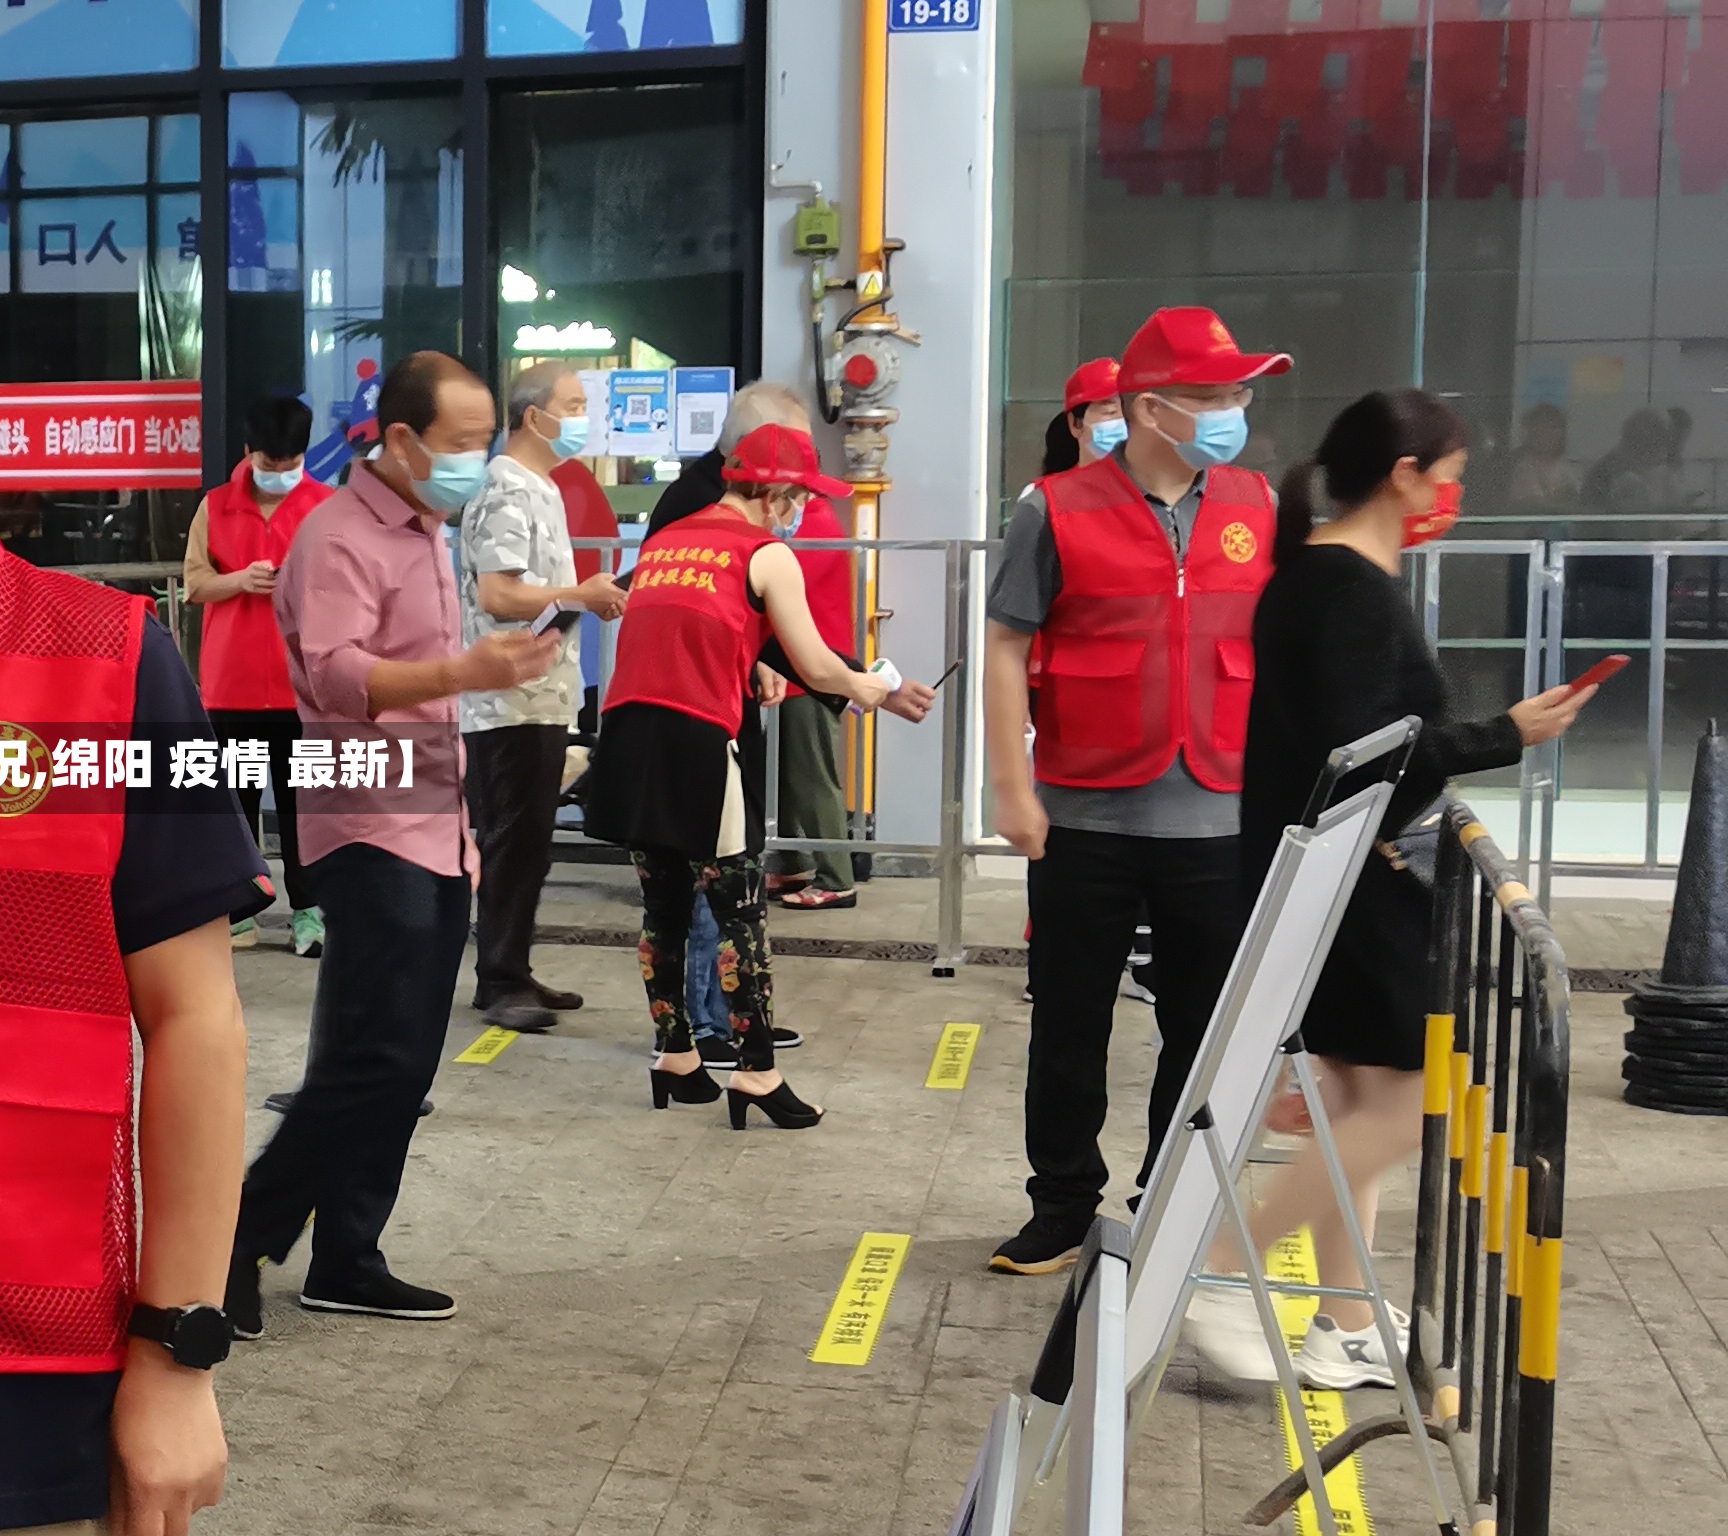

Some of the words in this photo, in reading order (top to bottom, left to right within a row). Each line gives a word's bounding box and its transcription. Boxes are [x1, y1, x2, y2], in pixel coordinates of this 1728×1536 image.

[45, 416, 135, 456] 自动感应门
